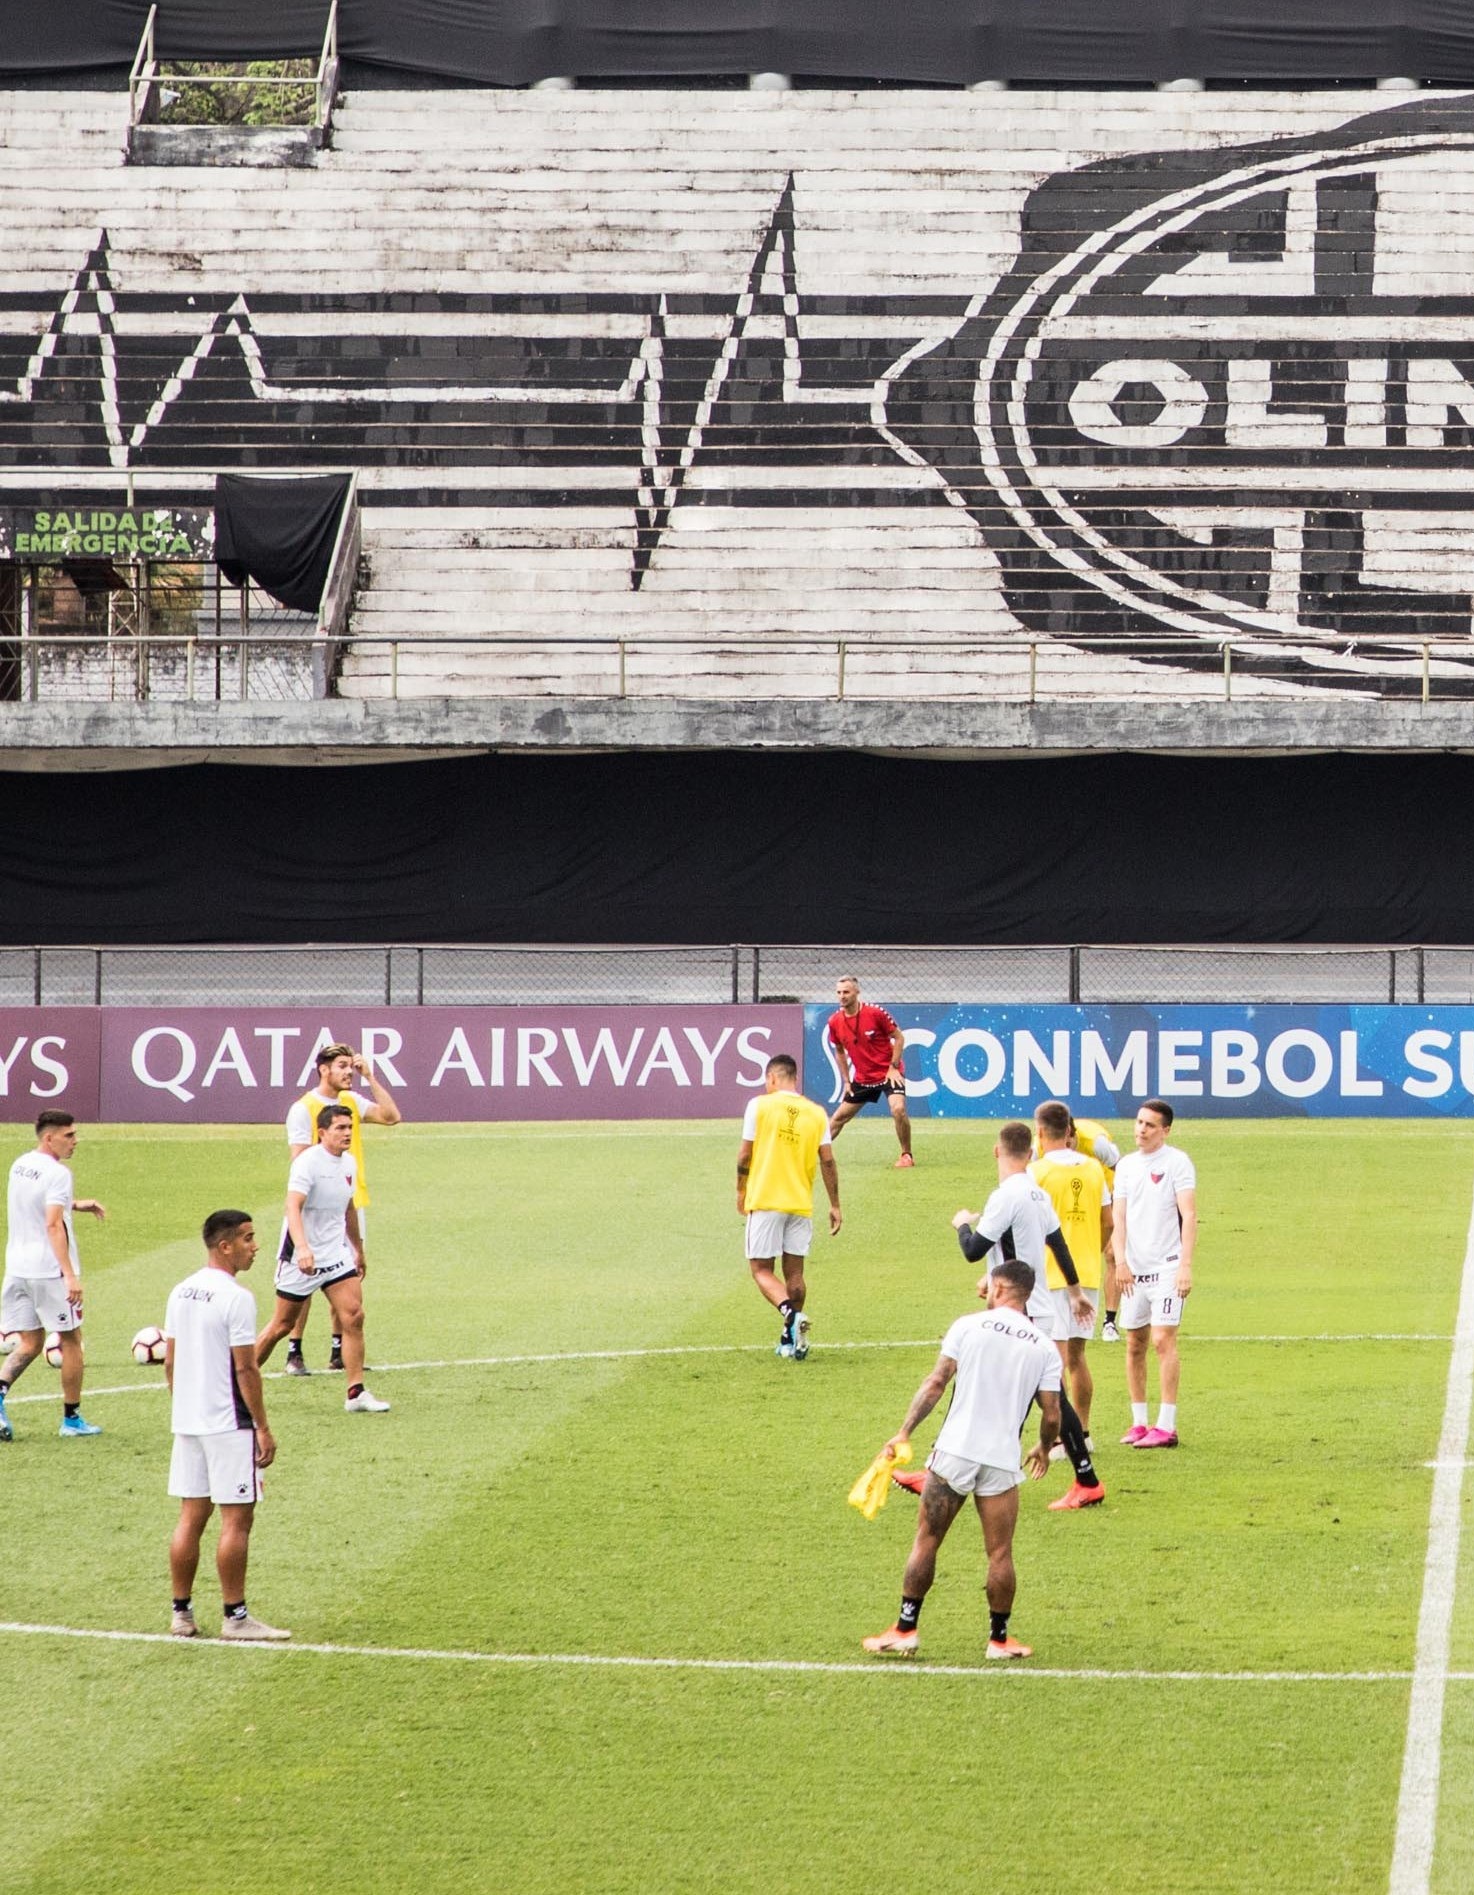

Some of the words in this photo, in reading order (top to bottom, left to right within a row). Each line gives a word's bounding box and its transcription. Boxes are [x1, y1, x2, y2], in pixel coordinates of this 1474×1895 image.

[35, 512, 139, 532] SALIDA
[142, 512, 172, 532] DE
[15, 533, 193, 552] EMERGENCIA
[131, 1026, 408, 1103] QATAR
[430, 1026, 773, 1088] AIRWAYS
[901, 1028, 1384, 1098] CONMEBOL
[1162, 1297, 1172, 1314] 8
[981, 1318, 1039, 1345] COLON
